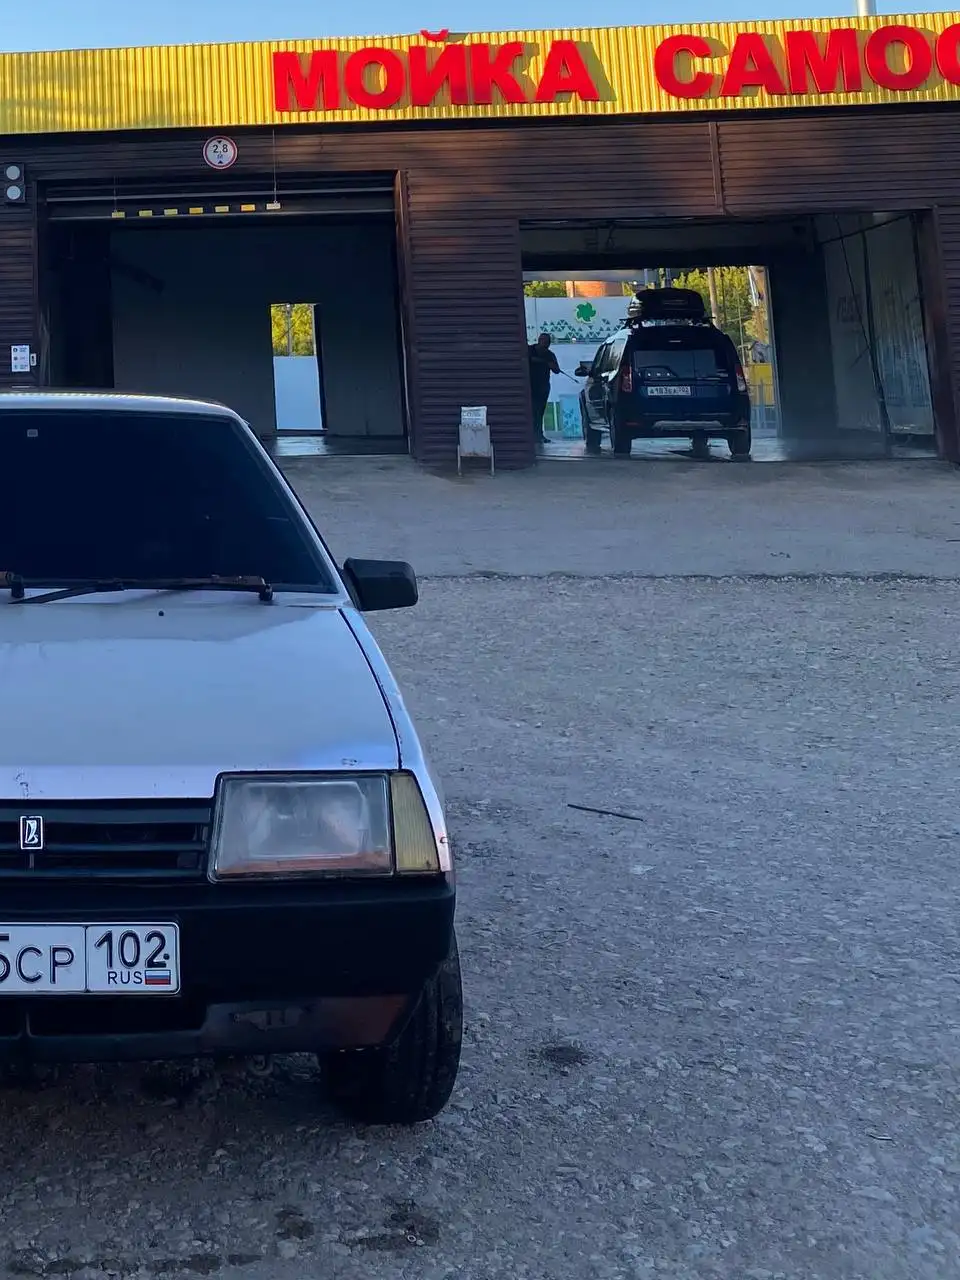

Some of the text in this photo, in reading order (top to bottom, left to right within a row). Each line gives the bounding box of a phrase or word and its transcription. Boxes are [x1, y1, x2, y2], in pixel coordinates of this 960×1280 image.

[273, 28, 600, 112] МОЙКА
[94, 930, 167, 968] 102
[107, 970, 143, 985] RUS
